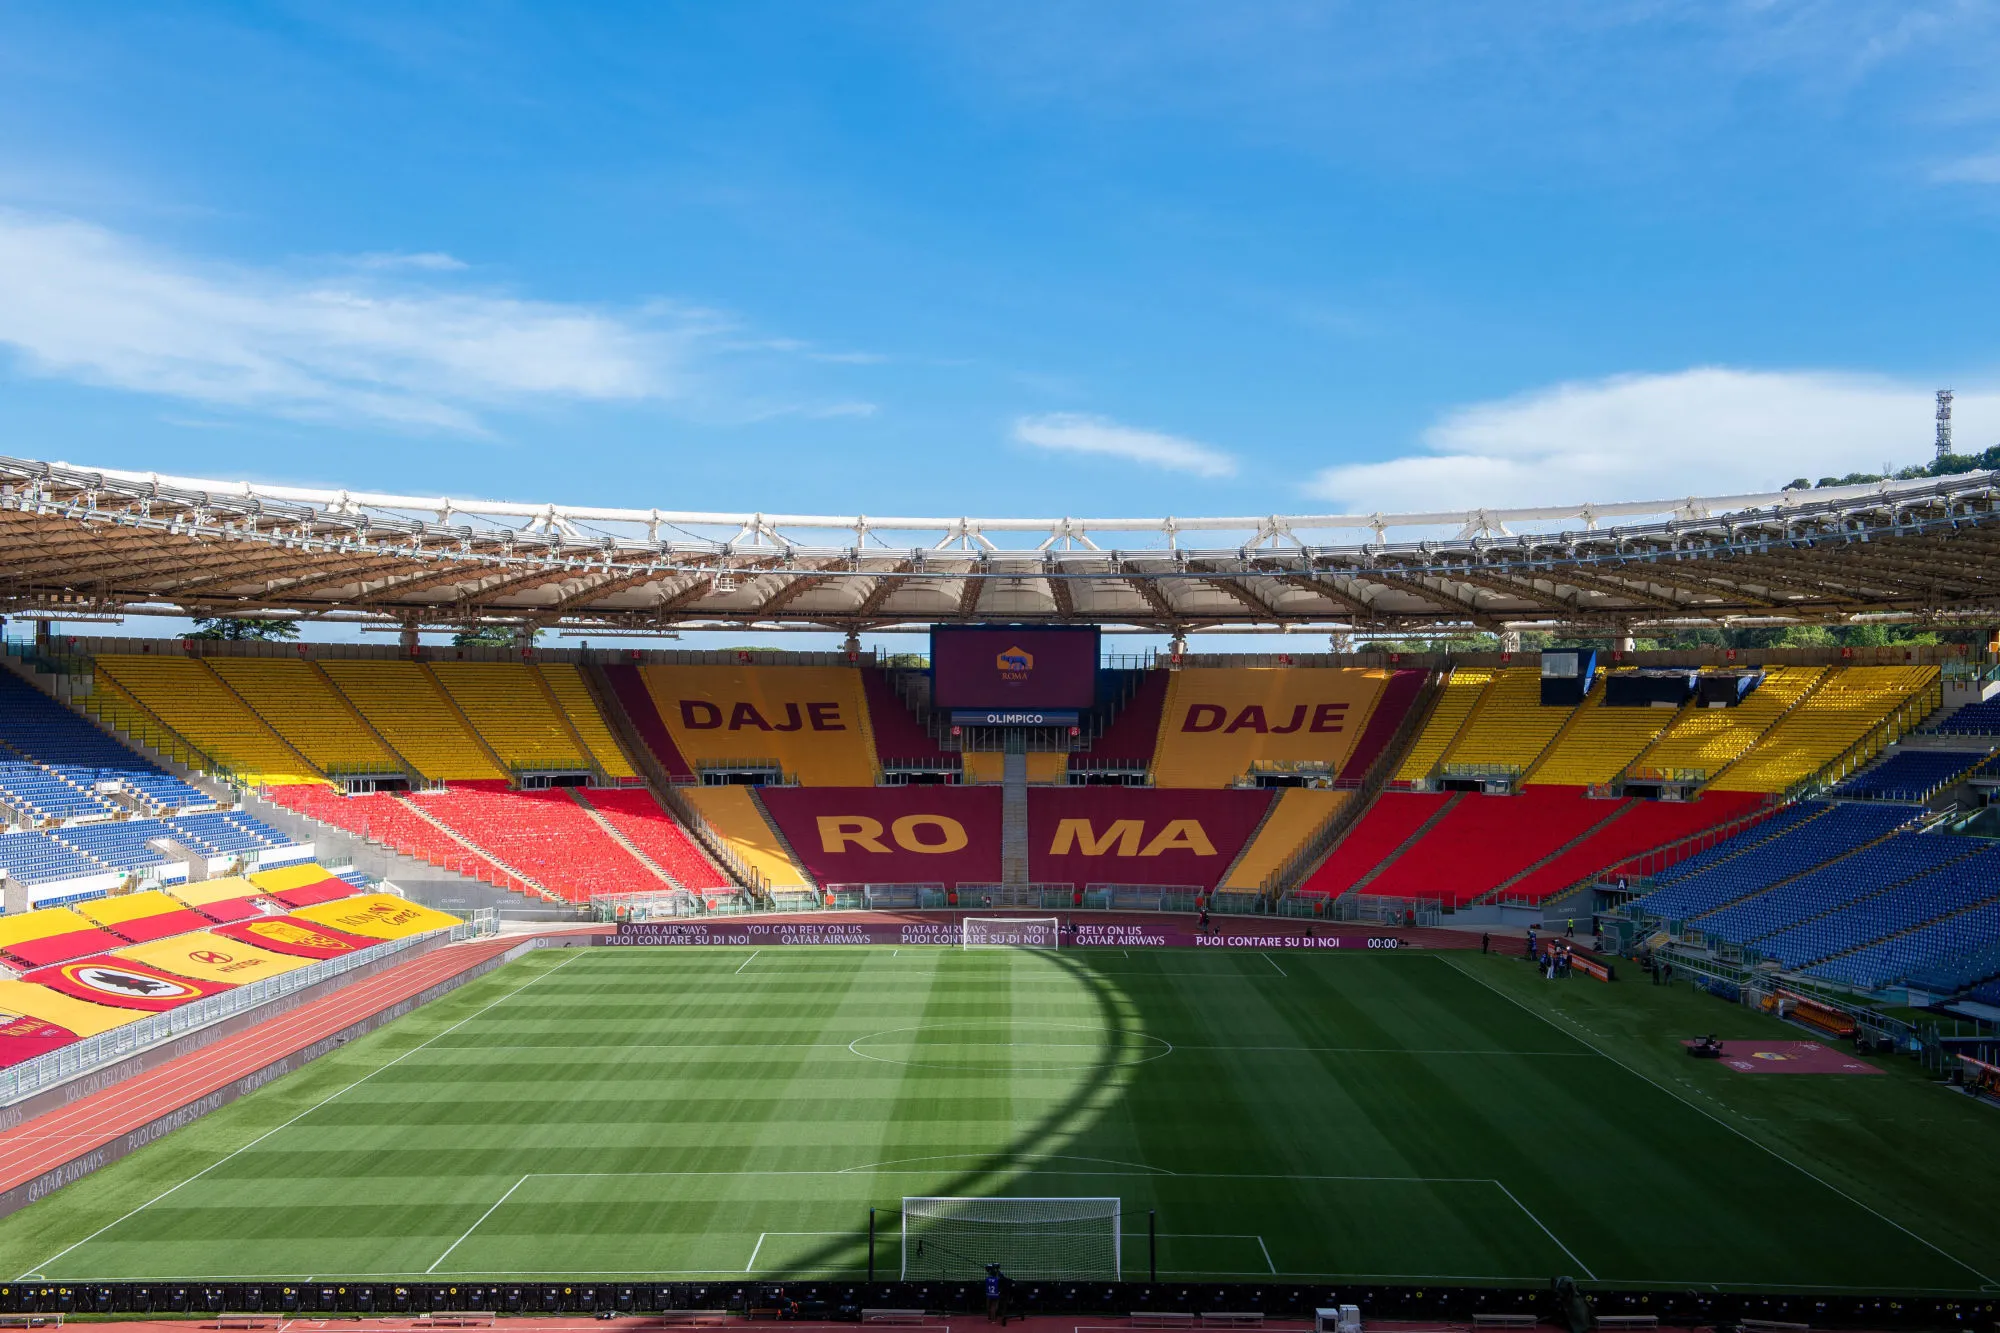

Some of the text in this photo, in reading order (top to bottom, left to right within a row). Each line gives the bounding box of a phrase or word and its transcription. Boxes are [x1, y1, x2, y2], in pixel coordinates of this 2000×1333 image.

[680, 700, 847, 731] DAJE
[987, 714, 1043, 723] OLIMPICO
[1181, 703, 1349, 734] DAJE
[816, 814, 1218, 857] RO MA
[747, 925, 863, 934] YOU CAN RELY ON US
[1026, 925, 1050, 934] YOU
[1079, 926, 1104, 935] RELY
[1107, 926, 1124, 935] ON
[1127, 926, 1142, 935] US
[605, 935, 751, 945] PUOI CONTARE SU DI NOI
[781, 934, 871, 945] QATAR AIRWAYS
[902, 934, 1045, 944] PUOI CONTARE SU DI NOI
[1076, 935, 1165, 945] QATAR AIRWAYS
[1196, 936, 1340, 947] PUOI CONTARE SU DI NOI
[1367, 938, 1398, 949] 00:00
[65, 1057, 143, 1102] YOU CAN RELY ON US
[128, 1128, 150, 1151] PUOI
[151, 1108, 188, 1140] CONTARE
[29, 1150, 104, 1202] QATAR AIRWAYS
